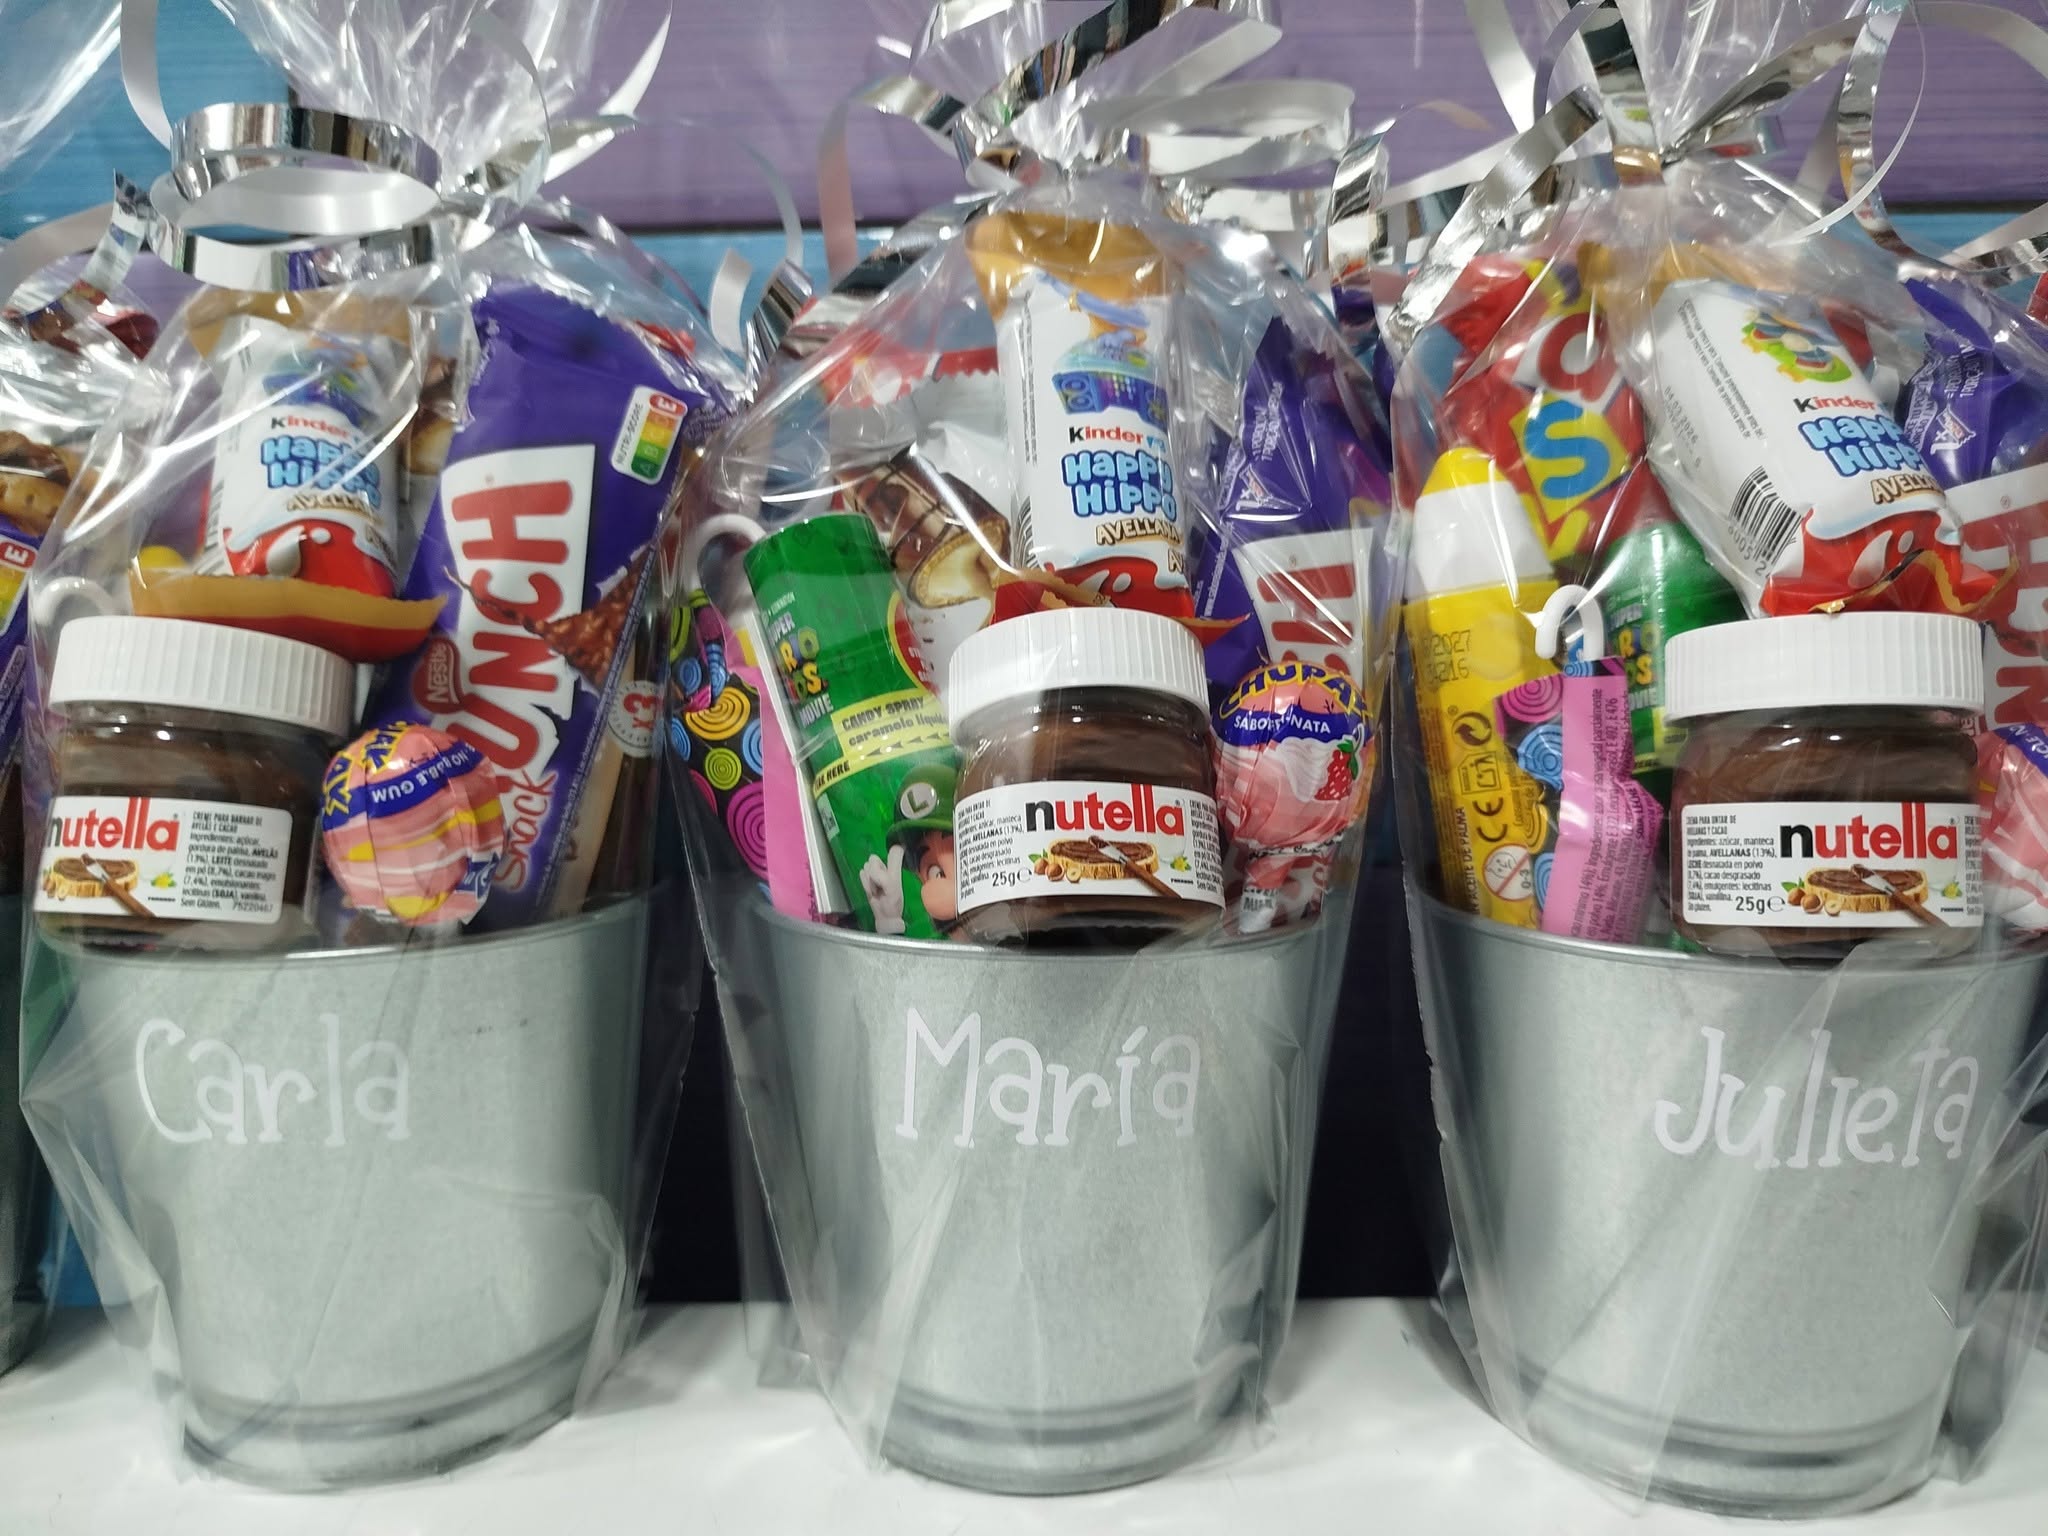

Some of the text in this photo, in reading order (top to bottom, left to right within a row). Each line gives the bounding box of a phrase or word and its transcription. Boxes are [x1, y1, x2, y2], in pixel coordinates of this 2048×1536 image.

[1069, 425, 1143, 444] Kinder
[1798, 415, 1905, 451] Happ
[1061, 450, 1174, 494] Happy
[1825, 441, 1924, 478] Hipp
[1071, 479, 1177, 522] Hippo
[1290, 714, 1331, 734] NATA
[371, 780, 415, 804] GUM
[1026, 783, 1185, 836] nutella
[1780, 800, 1958, 860] nutella
[1710, 848, 1751, 857] AVELLANAS
[1744, 861, 1763, 870] polvo
[1721, 871, 1760, 881] desgrasado
[136, 1012, 412, 1147] Carla
[895, 1007, 1201, 1149] María
[1654, 1025, 1980, 1171] Julieta
